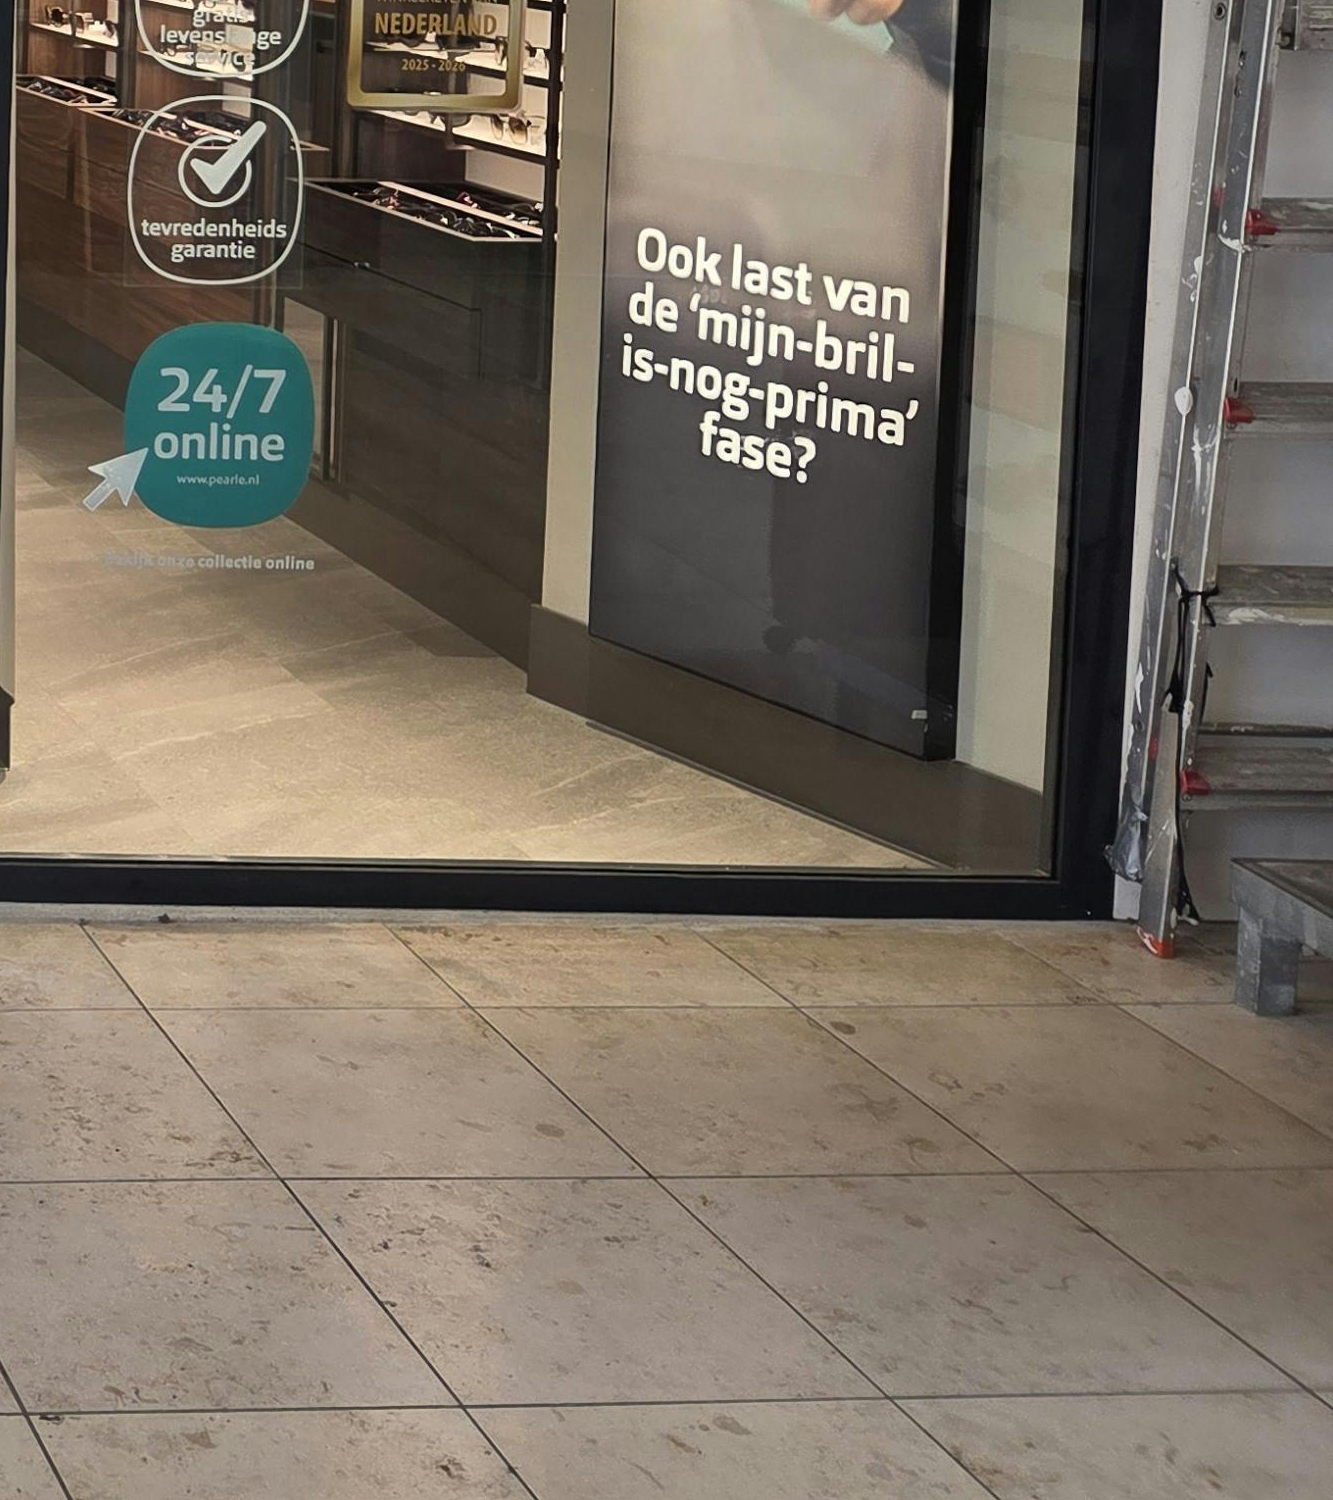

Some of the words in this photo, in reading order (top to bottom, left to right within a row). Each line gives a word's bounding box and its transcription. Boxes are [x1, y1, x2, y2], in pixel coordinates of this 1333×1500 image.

[192, 8, 249, 27] gratis
[375, 12, 497, 36] NEDERLAND
[159, 24, 282, 50] levensge
[401, 58, 429, 71] 2025
[142, 218, 287, 240] tevredenheids
[171, 238, 256, 262] garantie
[636, 226, 723, 287] Ook
[731, 242, 813, 306] last
[822, 273, 910, 325] van
[628, 281, 679, 334] de
[157, 364, 287, 418] 24/7
[153, 422, 285, 461] online
[700, 410, 818, 485] fase?
[176, 472, 261, 487] www.pearle.nl
[197, 554, 262, 570] collectie
[265, 555, 316, 570] online
